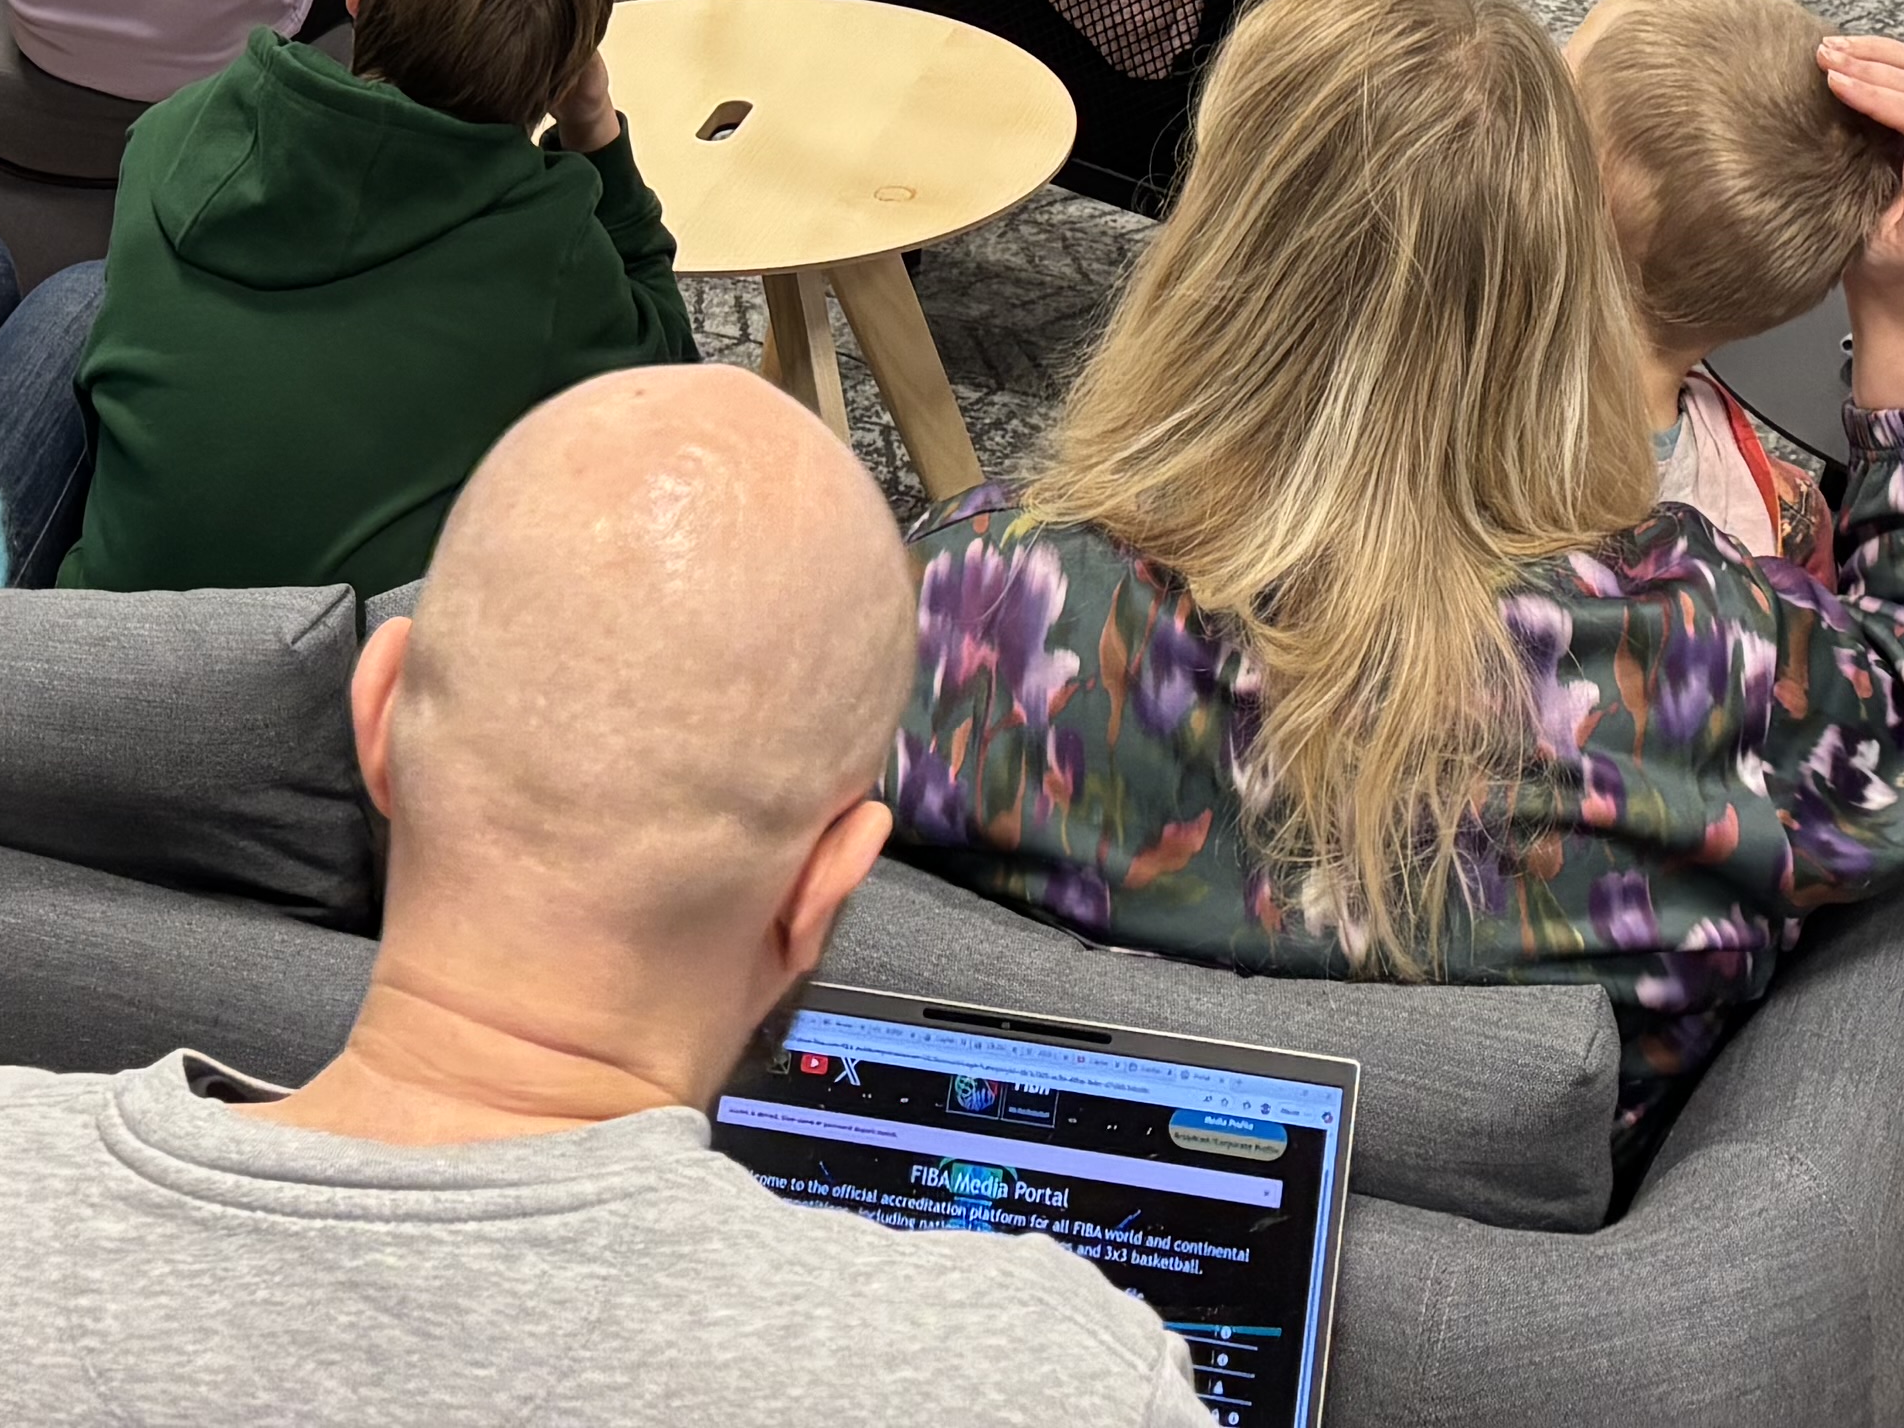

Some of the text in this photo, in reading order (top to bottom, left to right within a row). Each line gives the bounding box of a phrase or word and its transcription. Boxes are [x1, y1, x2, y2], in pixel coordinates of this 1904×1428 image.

[910, 1165, 1069, 1209] FIBA Media Portal
[752, 1171, 1250, 1263] come to the official accreditation platform for all FIBA world and continental
[1077, 1242, 1101, 1259] and
[1104, 1246, 1127, 1263] 3x3
[1131, 1250, 1203, 1275] basketball.
